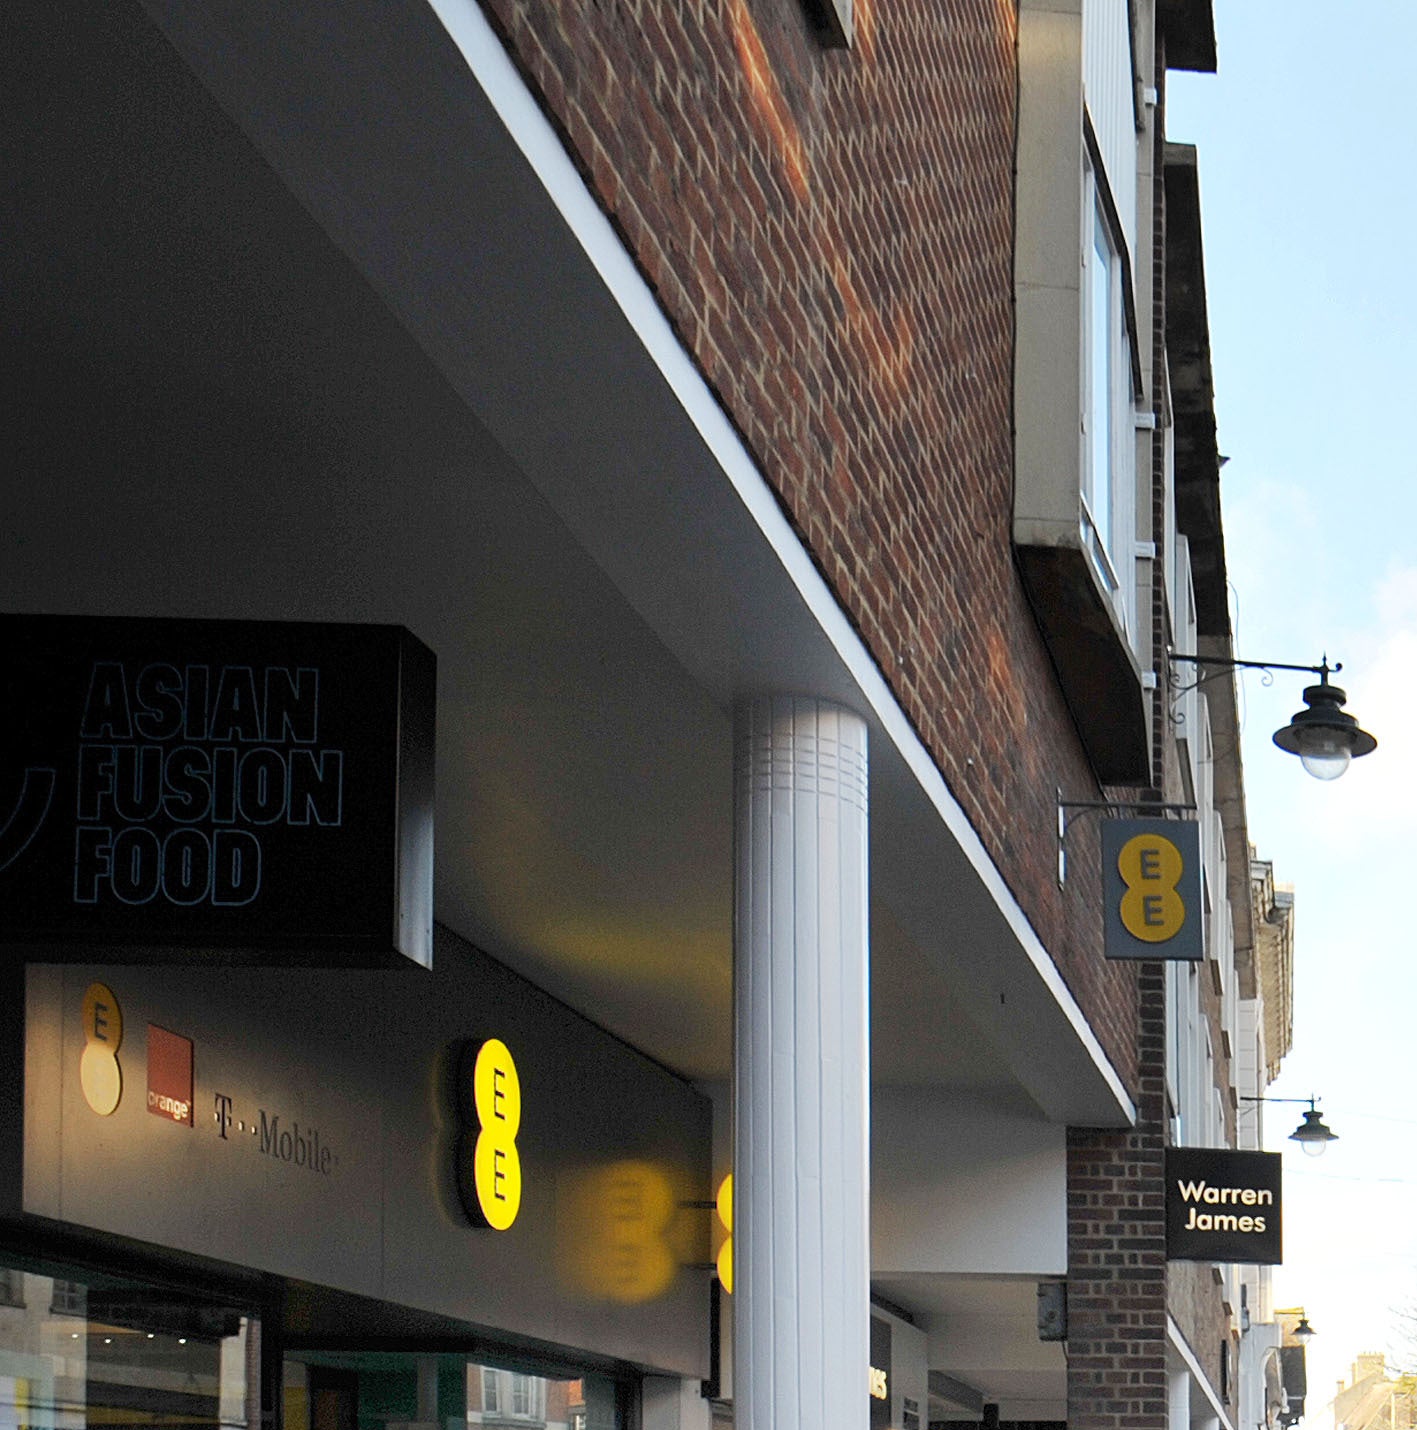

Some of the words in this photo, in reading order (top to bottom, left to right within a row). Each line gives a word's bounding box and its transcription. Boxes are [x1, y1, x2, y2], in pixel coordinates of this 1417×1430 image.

[79, 661, 319, 743] ASIAN
[76, 743, 343, 826] FUSION
[73, 825, 262, 906] FOOD
[1140, 849, 1165, 926] EE
[149, 1091, 189, 1120] orange
[1178, 1180, 1273, 1205] Warren
[1185, 1207, 1267, 1233] James
